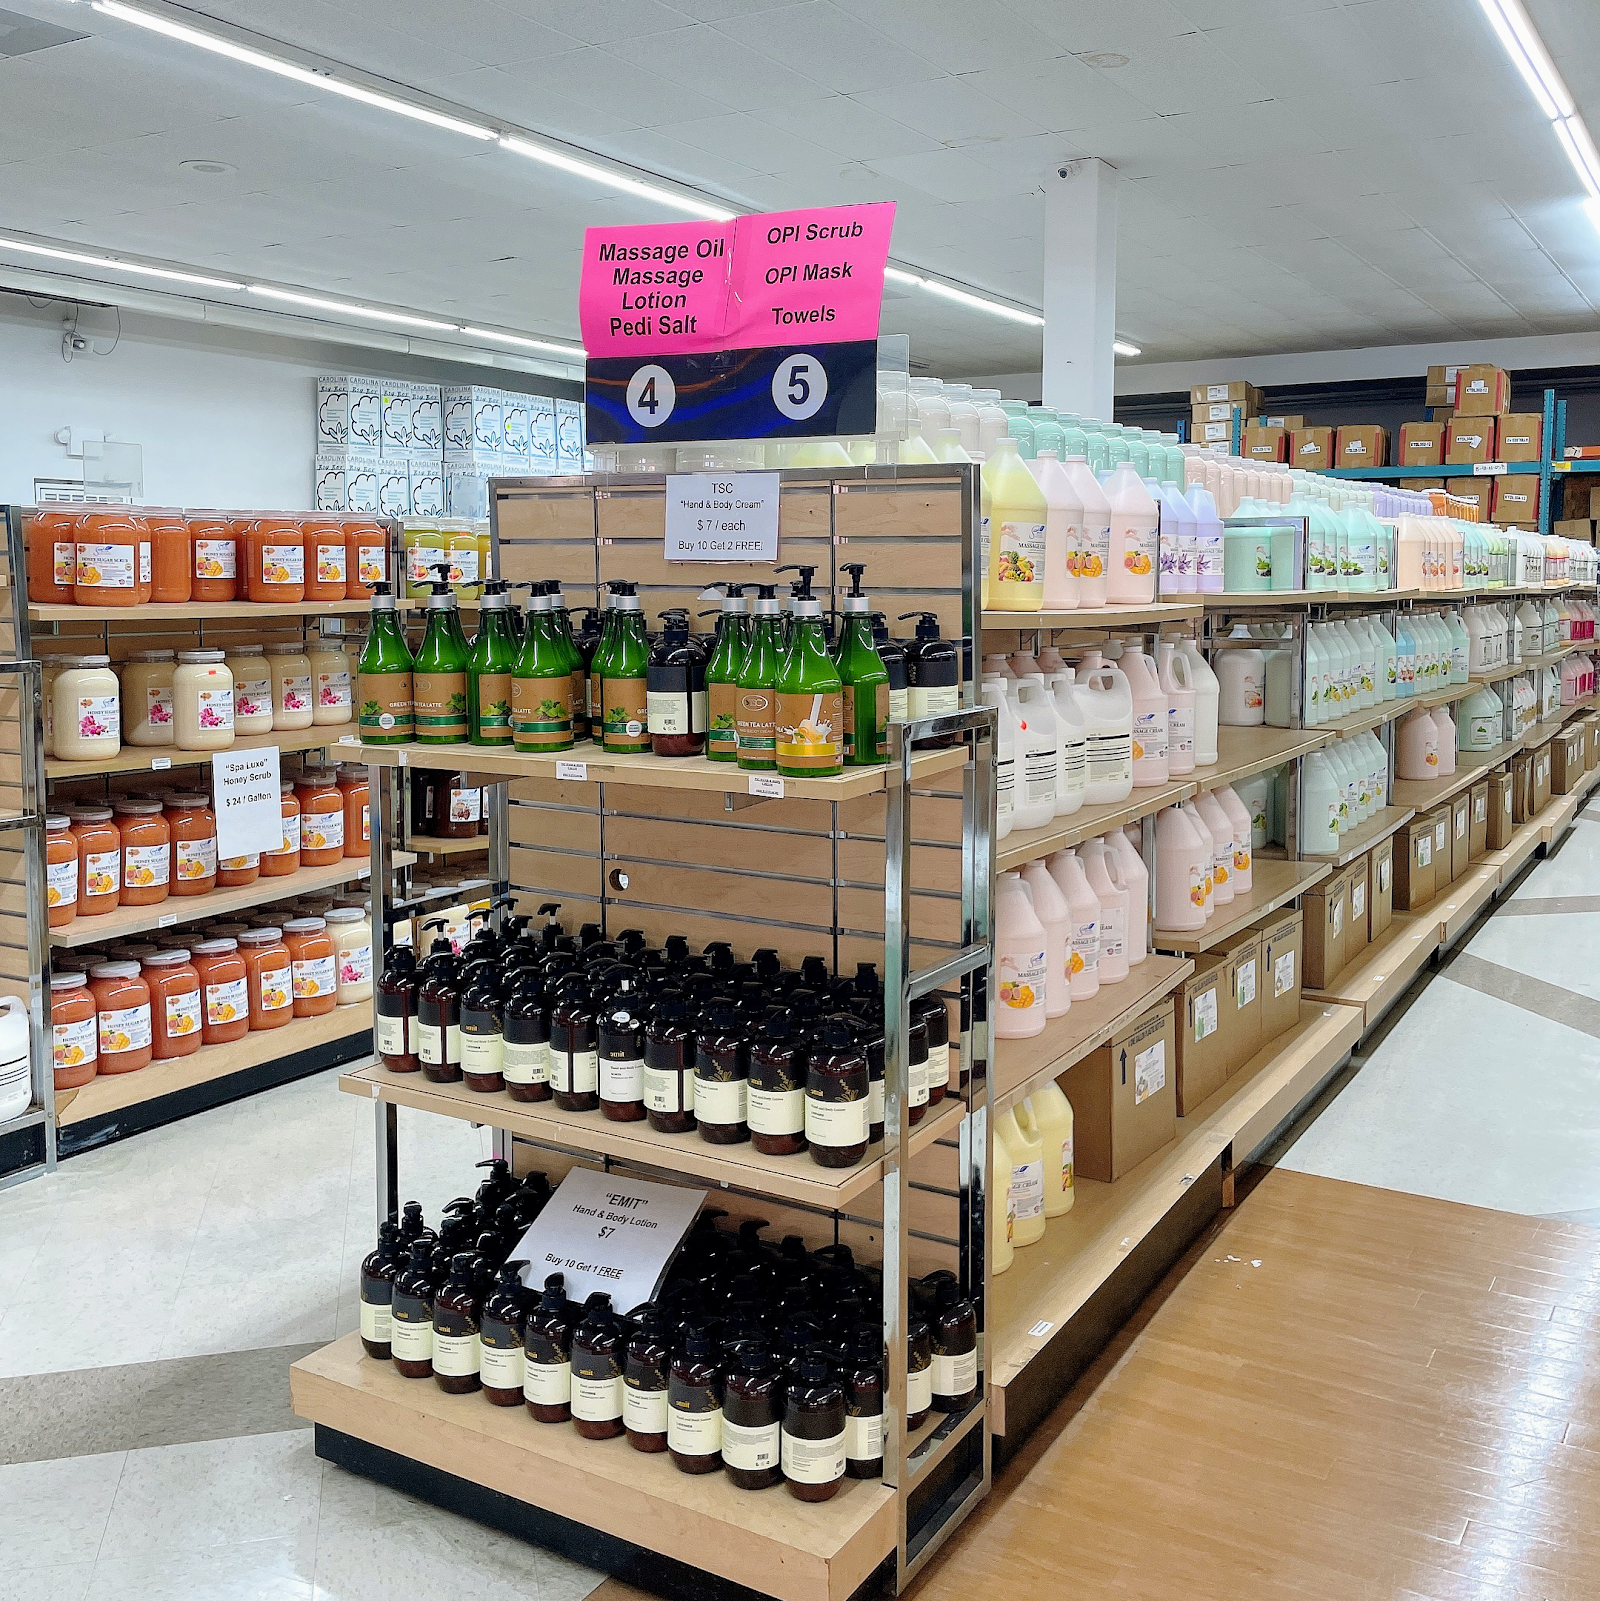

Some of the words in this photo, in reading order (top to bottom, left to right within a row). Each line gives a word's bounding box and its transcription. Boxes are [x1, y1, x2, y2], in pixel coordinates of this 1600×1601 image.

[767, 225, 799, 245] OPI
[806, 221, 863, 241] Scrub
[599, 244, 689, 263] Massage
[696, 238, 724, 258] Oil
[612, 268, 703, 287] Massage
[765, 266, 798, 285] OPI
[803, 262, 853, 281] Mask
[622, 290, 687, 310] Lotion
[771, 305, 836, 325] Towels
[610, 316, 652, 337] Pedi
[658, 315, 697, 334] Salt
[349, 377, 379, 385] CAROLINA
[381, 380, 409, 388] CAROLINA
[787, 365, 811, 405] 5
[444, 386, 471, 394] CAROLINA
[473, 387, 499, 395] CAROLINA
[502, 392, 527, 400] CAROLINA
[637, 376, 659, 415] 4
[711, 483, 733, 494] TSC
[705, 500, 712, 509] &
[713, 500, 733, 511] Body
[697, 519, 704, 531] $
[706, 520, 712, 531] 7
[721, 519, 746, 531] each
[678, 541, 694, 552] Buy
[698, 541, 707, 550] 10
[710, 541, 725, 550] Get
[727, 541, 733, 550] 2
[735, 541, 763, 551] FREE!
[223, 776, 247, 787] Honey
[249, 771, 272, 782] Scrub
[226, 798, 231, 808] $
[232, 796, 241, 806] 24
[248, 791, 272, 803] Gallon
[572, 1204, 598, 1219] Hand
[597, 1210, 604, 1219] &
[606, 1212, 629, 1225] Body
[629, 1217, 658, 1230] Lotion
[598, 1225, 615, 1239] $7
[545, 1253, 563, 1266] Buy
[565, 1257, 575, 1269] 10
[576, 1261, 592, 1273] Get
[598, 1265, 624, 1279] FREE
